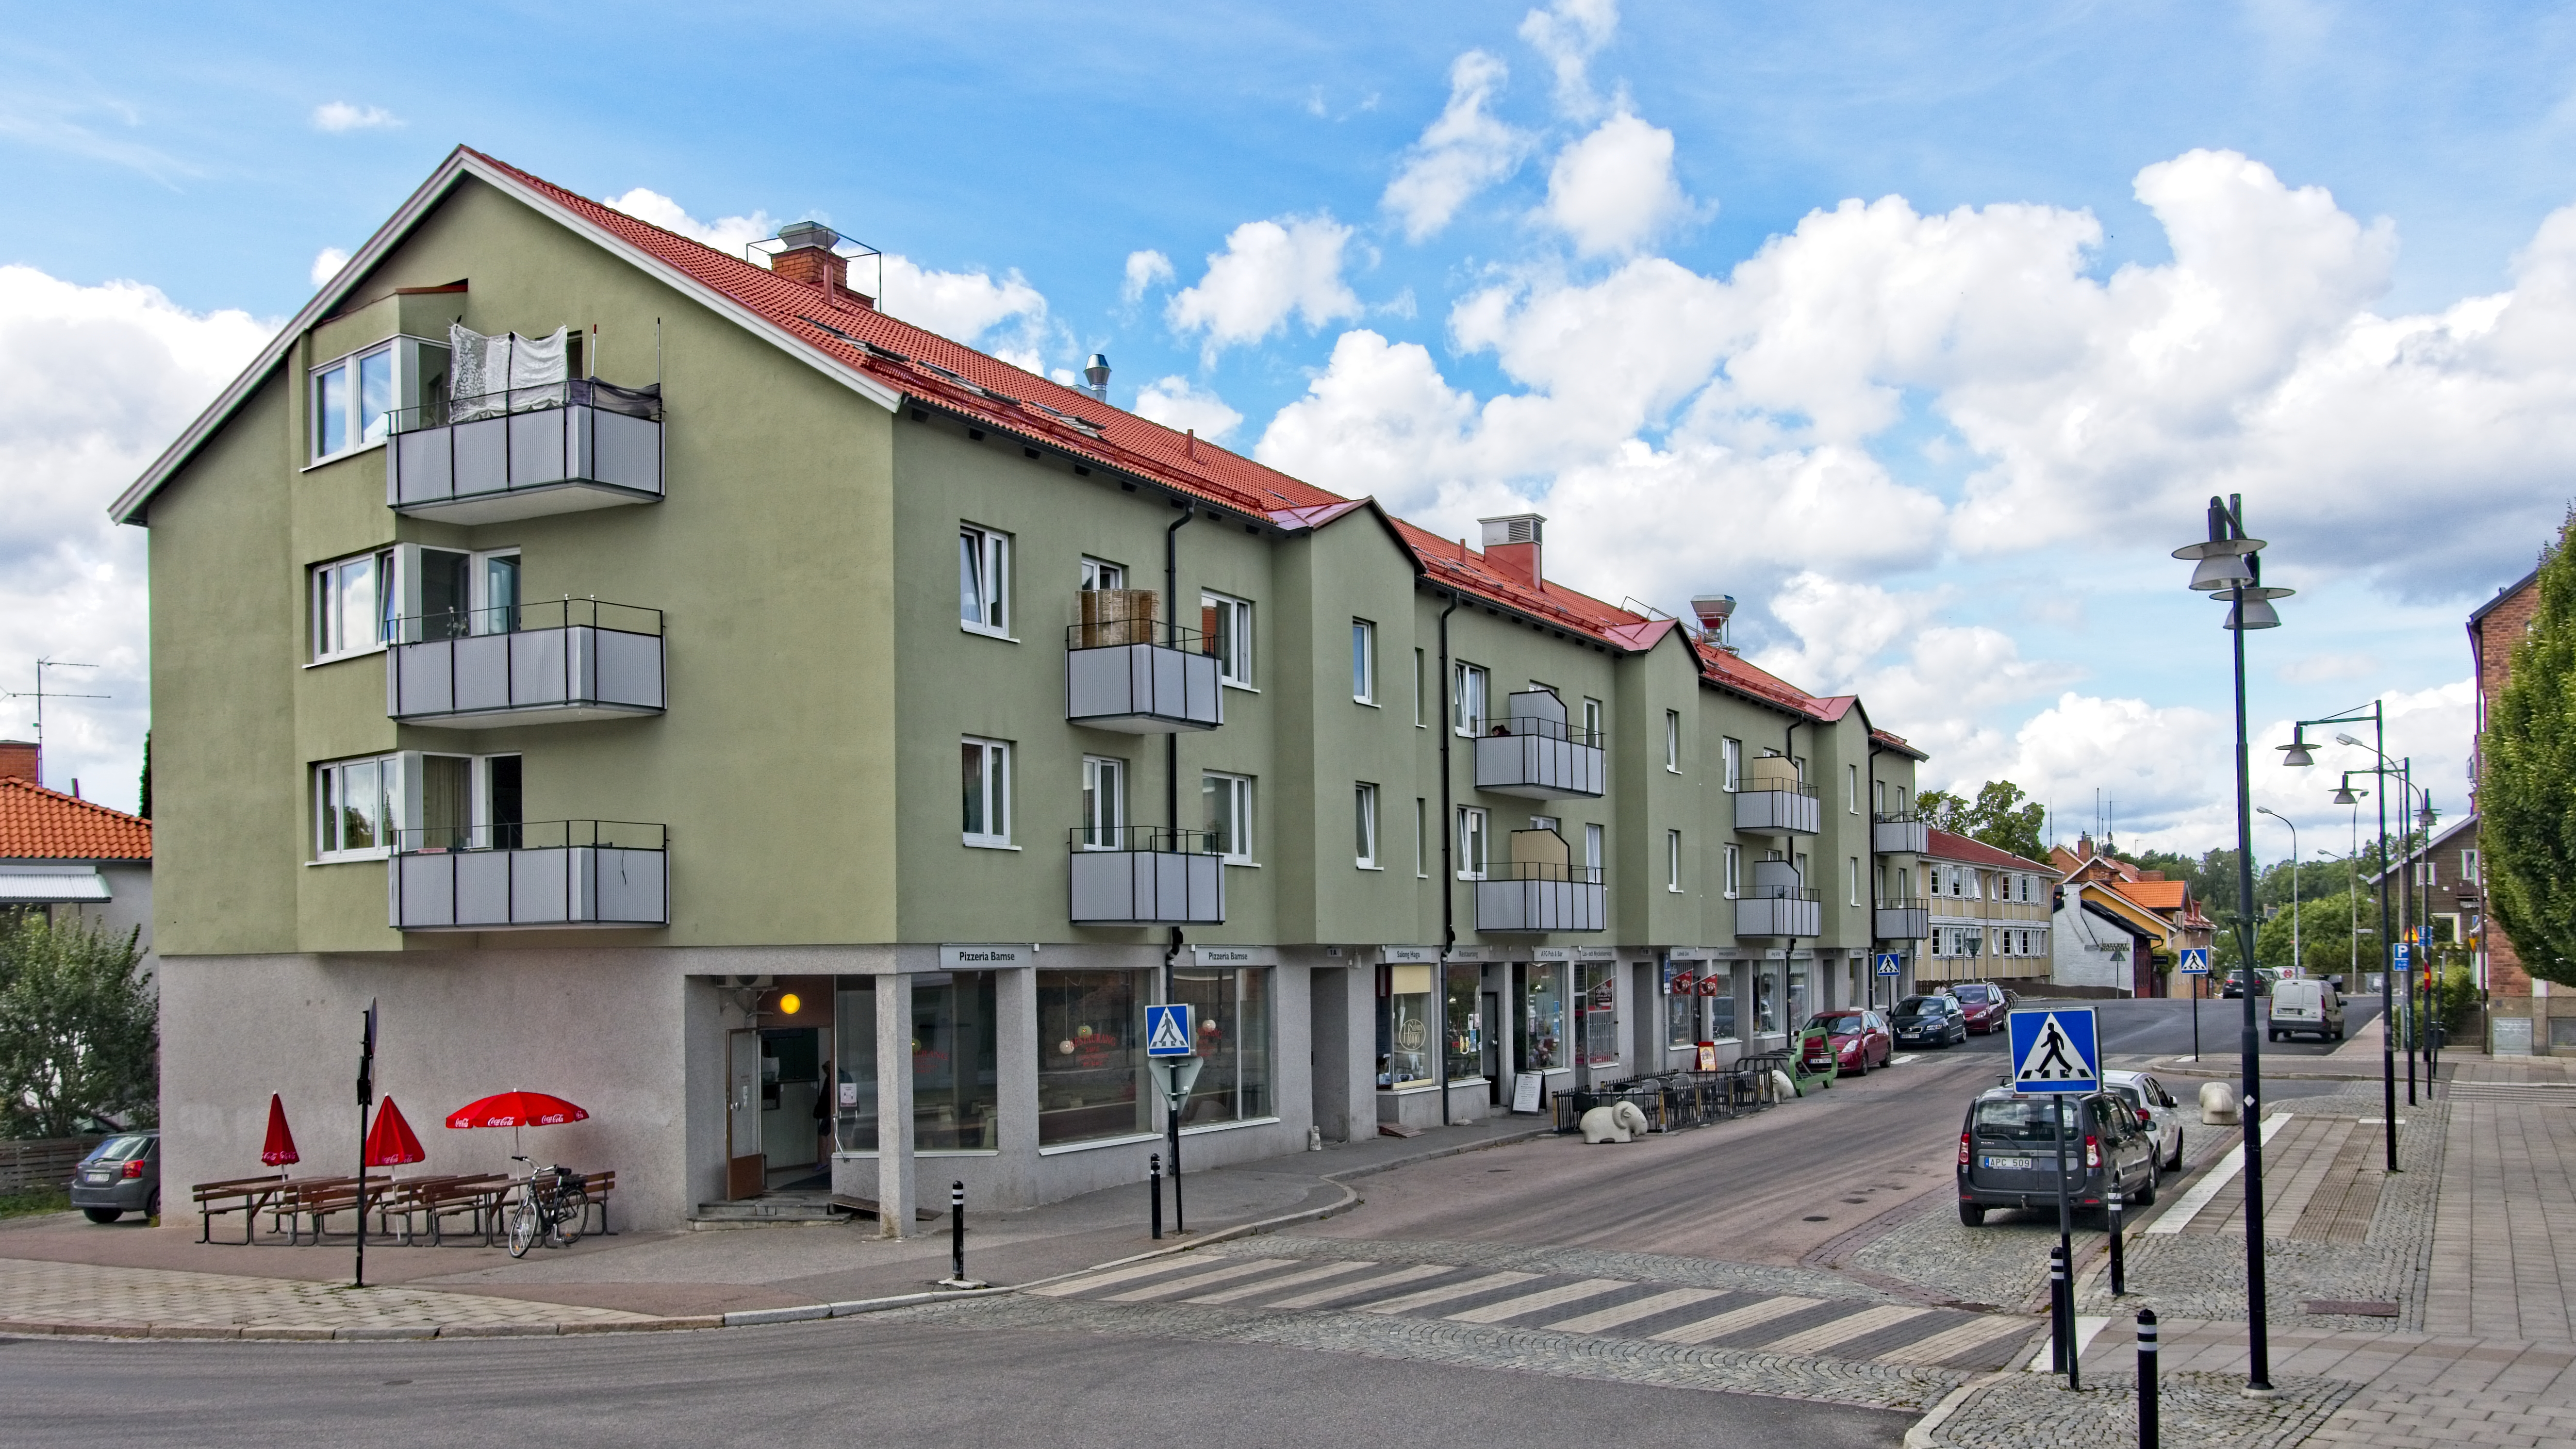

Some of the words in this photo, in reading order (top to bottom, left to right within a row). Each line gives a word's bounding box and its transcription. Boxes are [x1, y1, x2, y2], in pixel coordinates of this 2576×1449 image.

[1397, 951, 1409, 959] Salong
[1410, 951, 1420, 959] Haga
[1459, 951, 1478, 959] Restaurang
[2398, 945, 2409, 957] P
[959, 952, 989, 961] Pizzeria
[991, 952, 1015, 960] Bamse
[1404, 1023, 1420, 1048] Haga
[1070, 1033, 1116, 1050] RESTAURANG
[2013, 1159, 2029, 1167] 509
